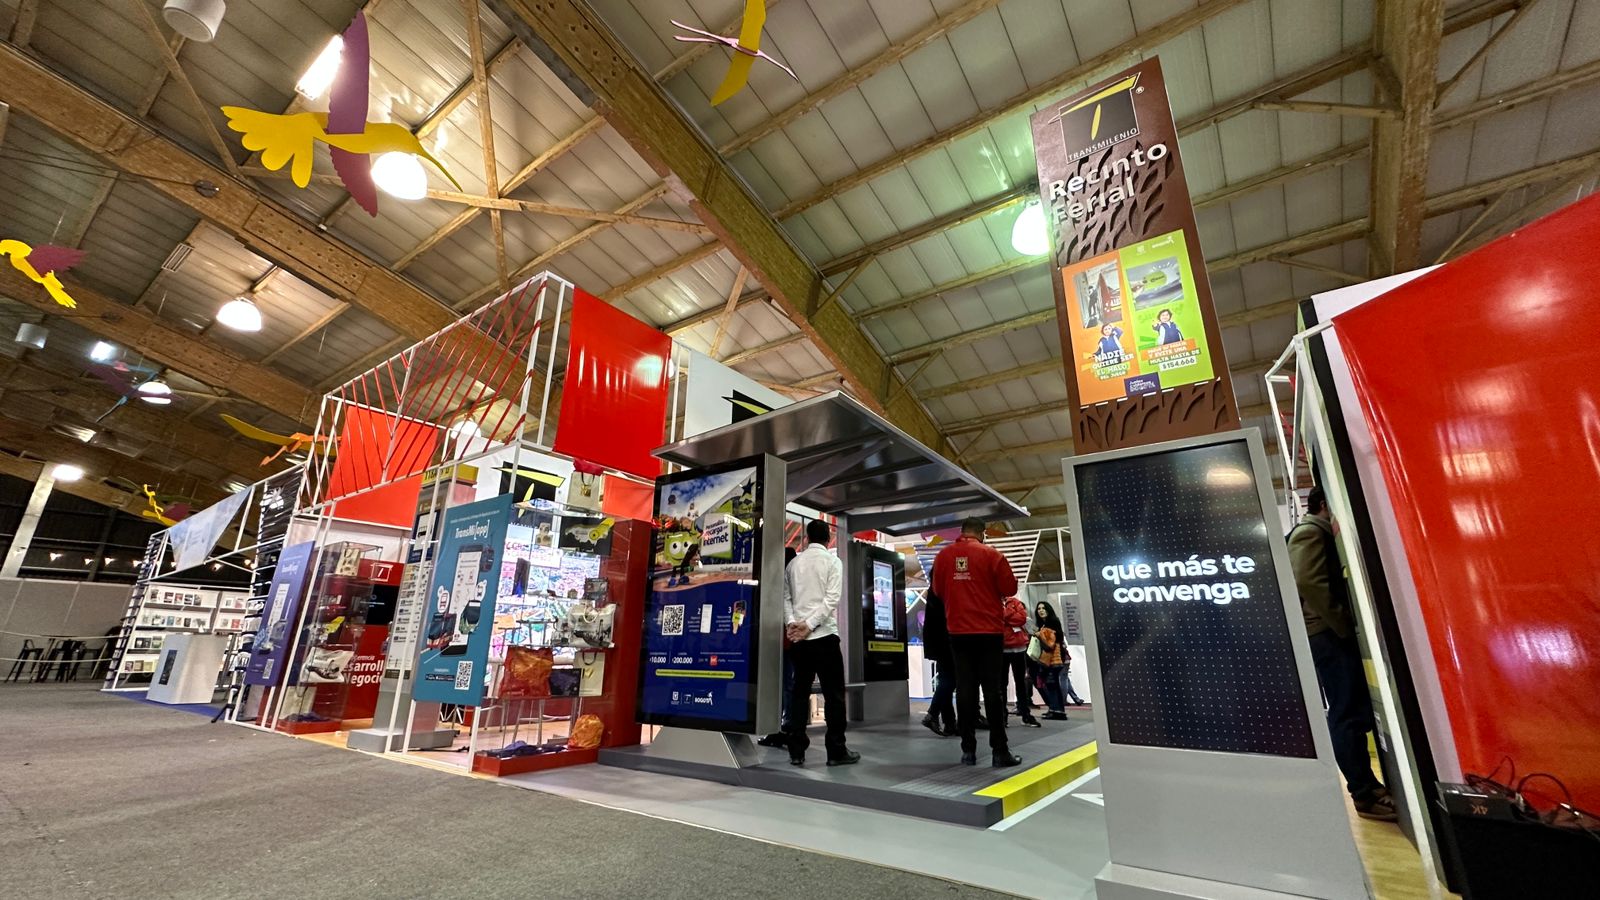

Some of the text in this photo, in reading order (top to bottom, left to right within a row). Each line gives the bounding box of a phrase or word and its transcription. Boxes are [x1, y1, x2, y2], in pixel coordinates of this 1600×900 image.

[1067, 127, 1138, 161] TRANSMILENIO
[1049, 143, 1167, 201] Recinto
[1053, 176, 1135, 226] Ferial
[1102, 554, 1255, 584] que más te
[1113, 582, 1250, 604] convenga
[1472, 804, 1488, 815] 4K
